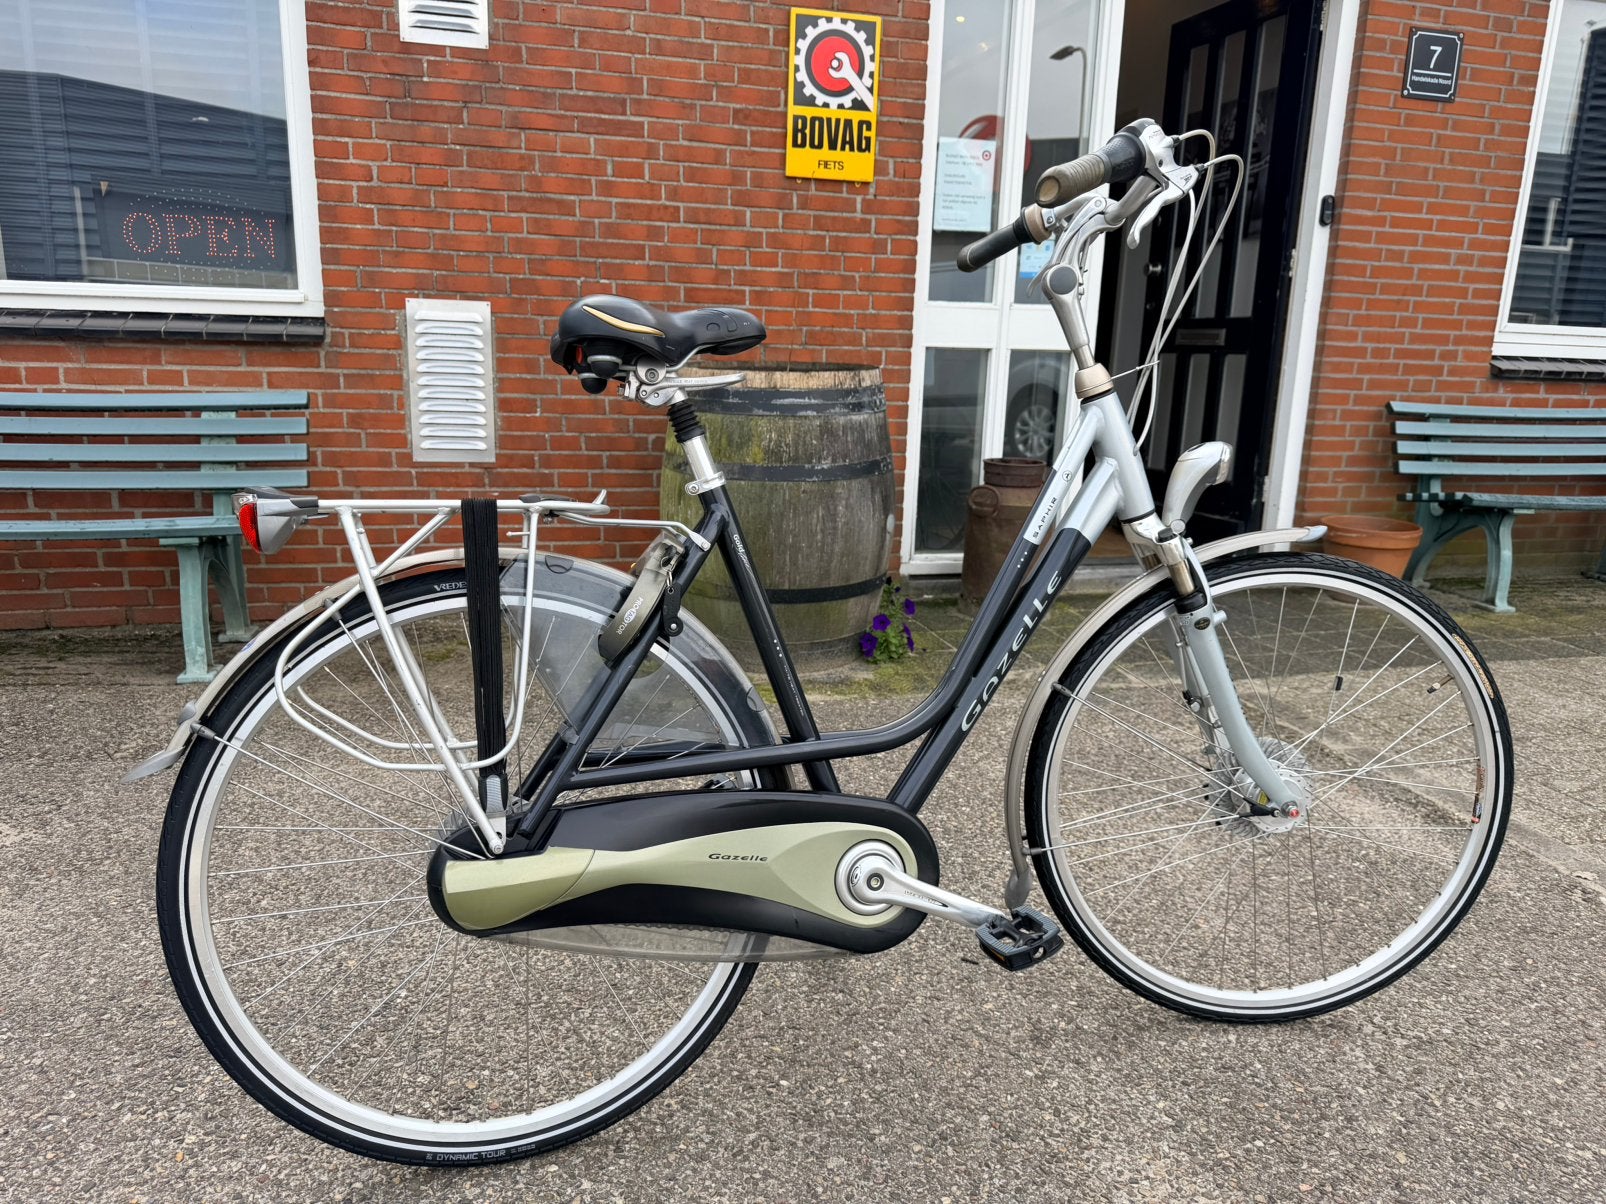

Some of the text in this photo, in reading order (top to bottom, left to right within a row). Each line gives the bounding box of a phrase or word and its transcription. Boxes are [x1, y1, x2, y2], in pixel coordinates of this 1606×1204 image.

[1430, 45, 1442, 69] 7
[791, 114, 872, 153] BOVAG
[817, 159, 844, 171] FIETS
[123, 212, 275, 259] OPEN
[1033, 496, 1057, 538] SAPHIR
[961, 570, 1062, 732] GAZELLE
[708, 853, 768, 861] Gazelle
[436, 1152, 478, 1161] DYNAMIC
[481, 1149, 506, 1159] TOUR
